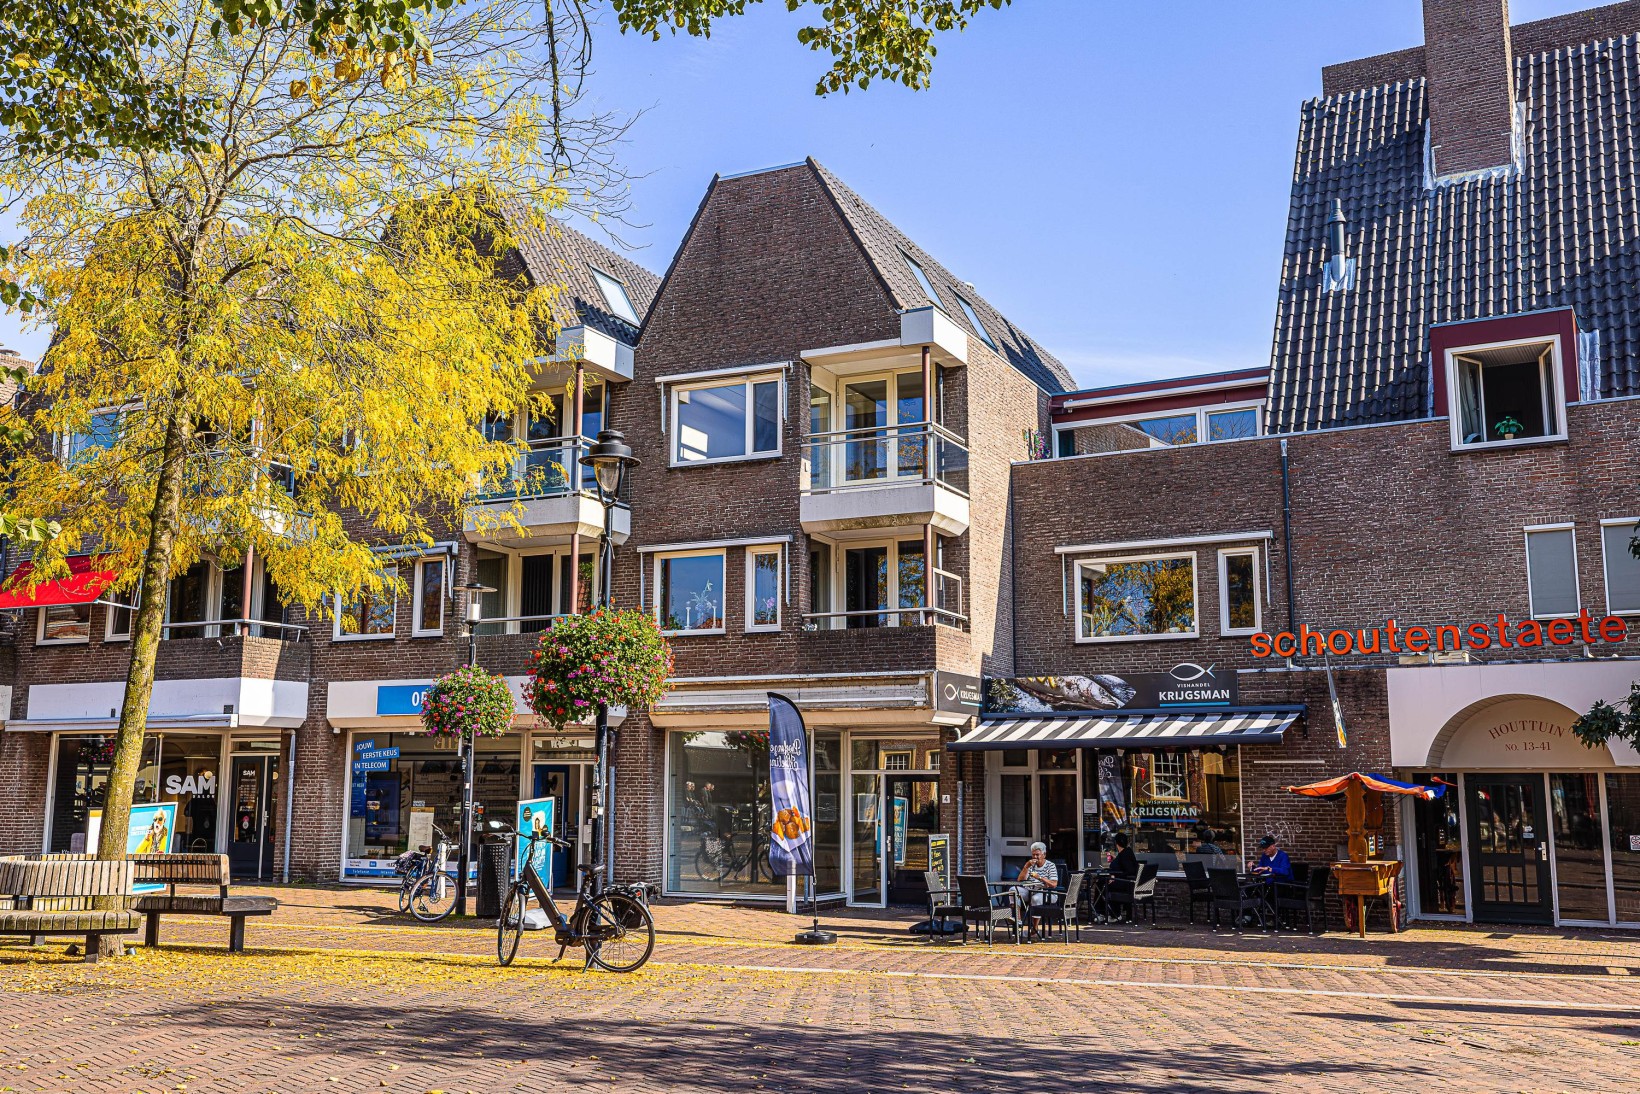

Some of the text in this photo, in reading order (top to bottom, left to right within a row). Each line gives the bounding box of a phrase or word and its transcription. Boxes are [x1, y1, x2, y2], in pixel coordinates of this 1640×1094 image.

[1250, 607, 1628, 658] schoutenstaete
[1158, 689, 1230, 701] KRIJGSMAN
[1488, 720, 1566, 740] HOUTTUIN
[356, 741, 373, 751] JOUW
[1523, 741, 1552, 751] 13-41
[362, 749, 397, 760] EERSTE KEUS
[242, 769, 256, 777] SAM
[165, 774, 216, 795] SAM
[1130, 807, 1198, 817] KRIJGSMAN
